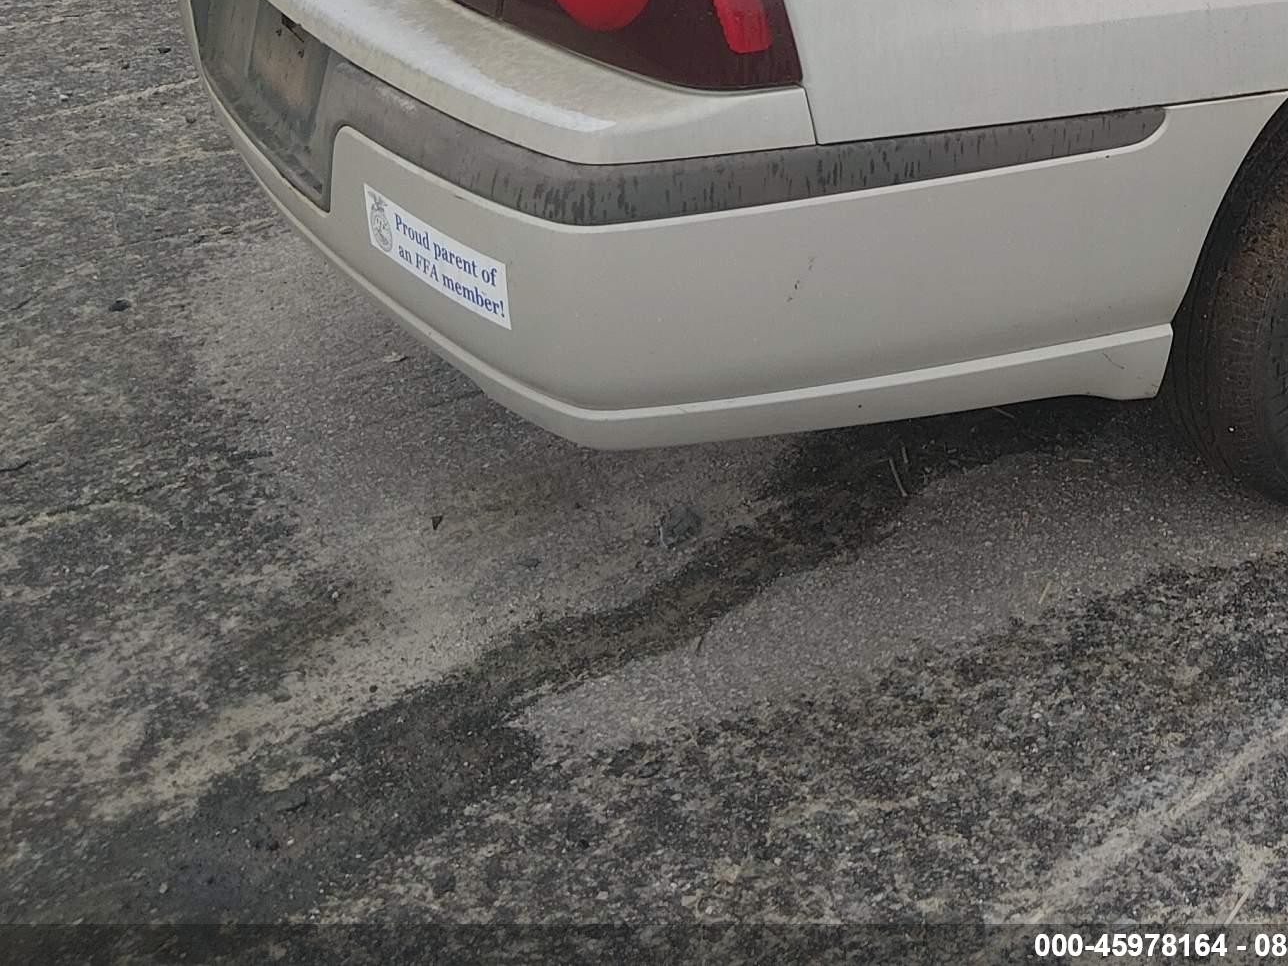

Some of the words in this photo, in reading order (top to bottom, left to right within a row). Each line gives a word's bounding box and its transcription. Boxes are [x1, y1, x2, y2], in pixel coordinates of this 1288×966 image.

[394, 213, 430, 250] Proud
[432, 241, 478, 278] parent
[481, 267, 498, 287] of
[398, 244, 413, 265] an
[415, 252, 440, 283] FFA
[441, 274, 505, 318] member!
